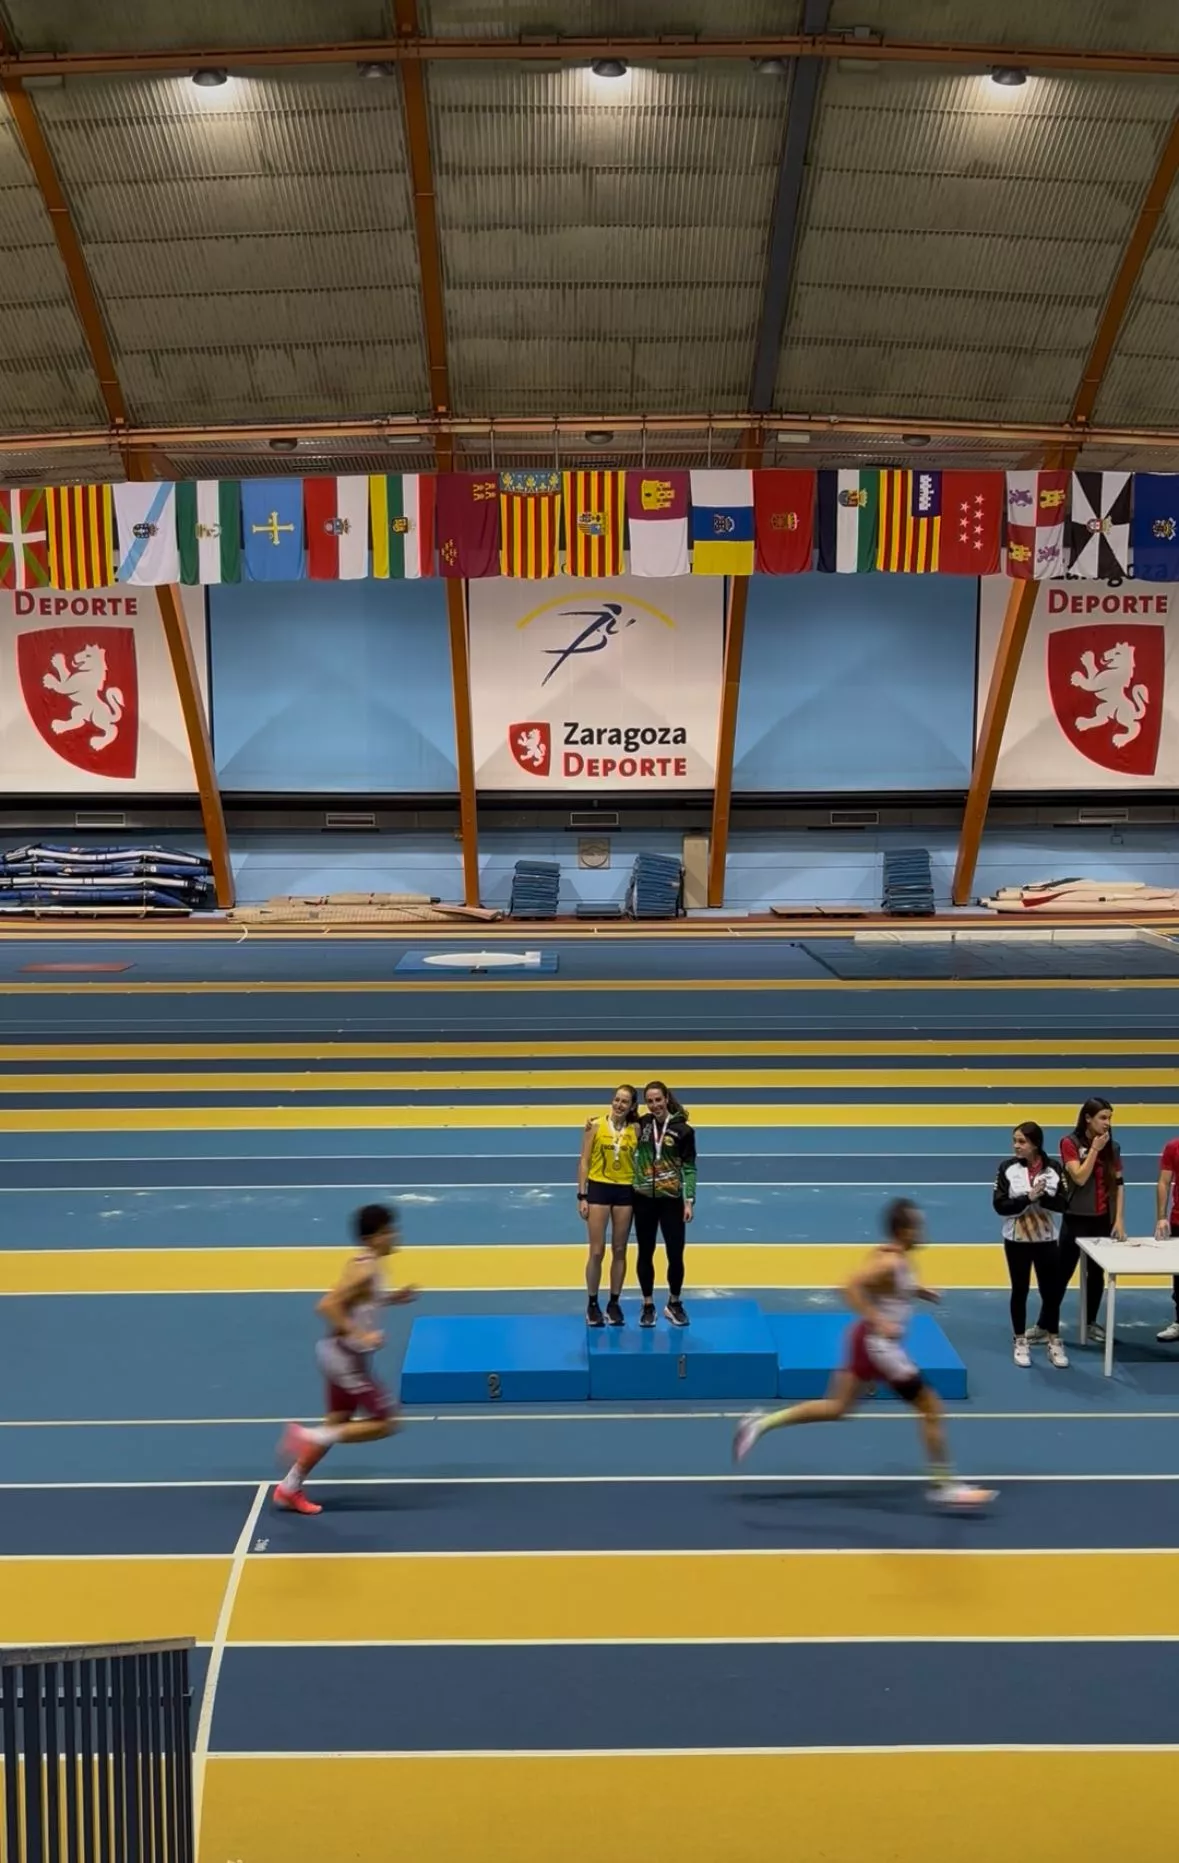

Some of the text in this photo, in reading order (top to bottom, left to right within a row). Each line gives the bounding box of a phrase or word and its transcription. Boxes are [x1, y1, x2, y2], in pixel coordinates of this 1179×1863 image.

[15, 591, 138, 616] DEPORTE
[1048, 589, 1168, 614] DEPORTE
[563, 722, 687, 753] Zaragoza
[563, 752, 687, 777] DEPORTE
[677, 1354, 687, 1379] 1
[487, 1373, 502, 1400] 2
